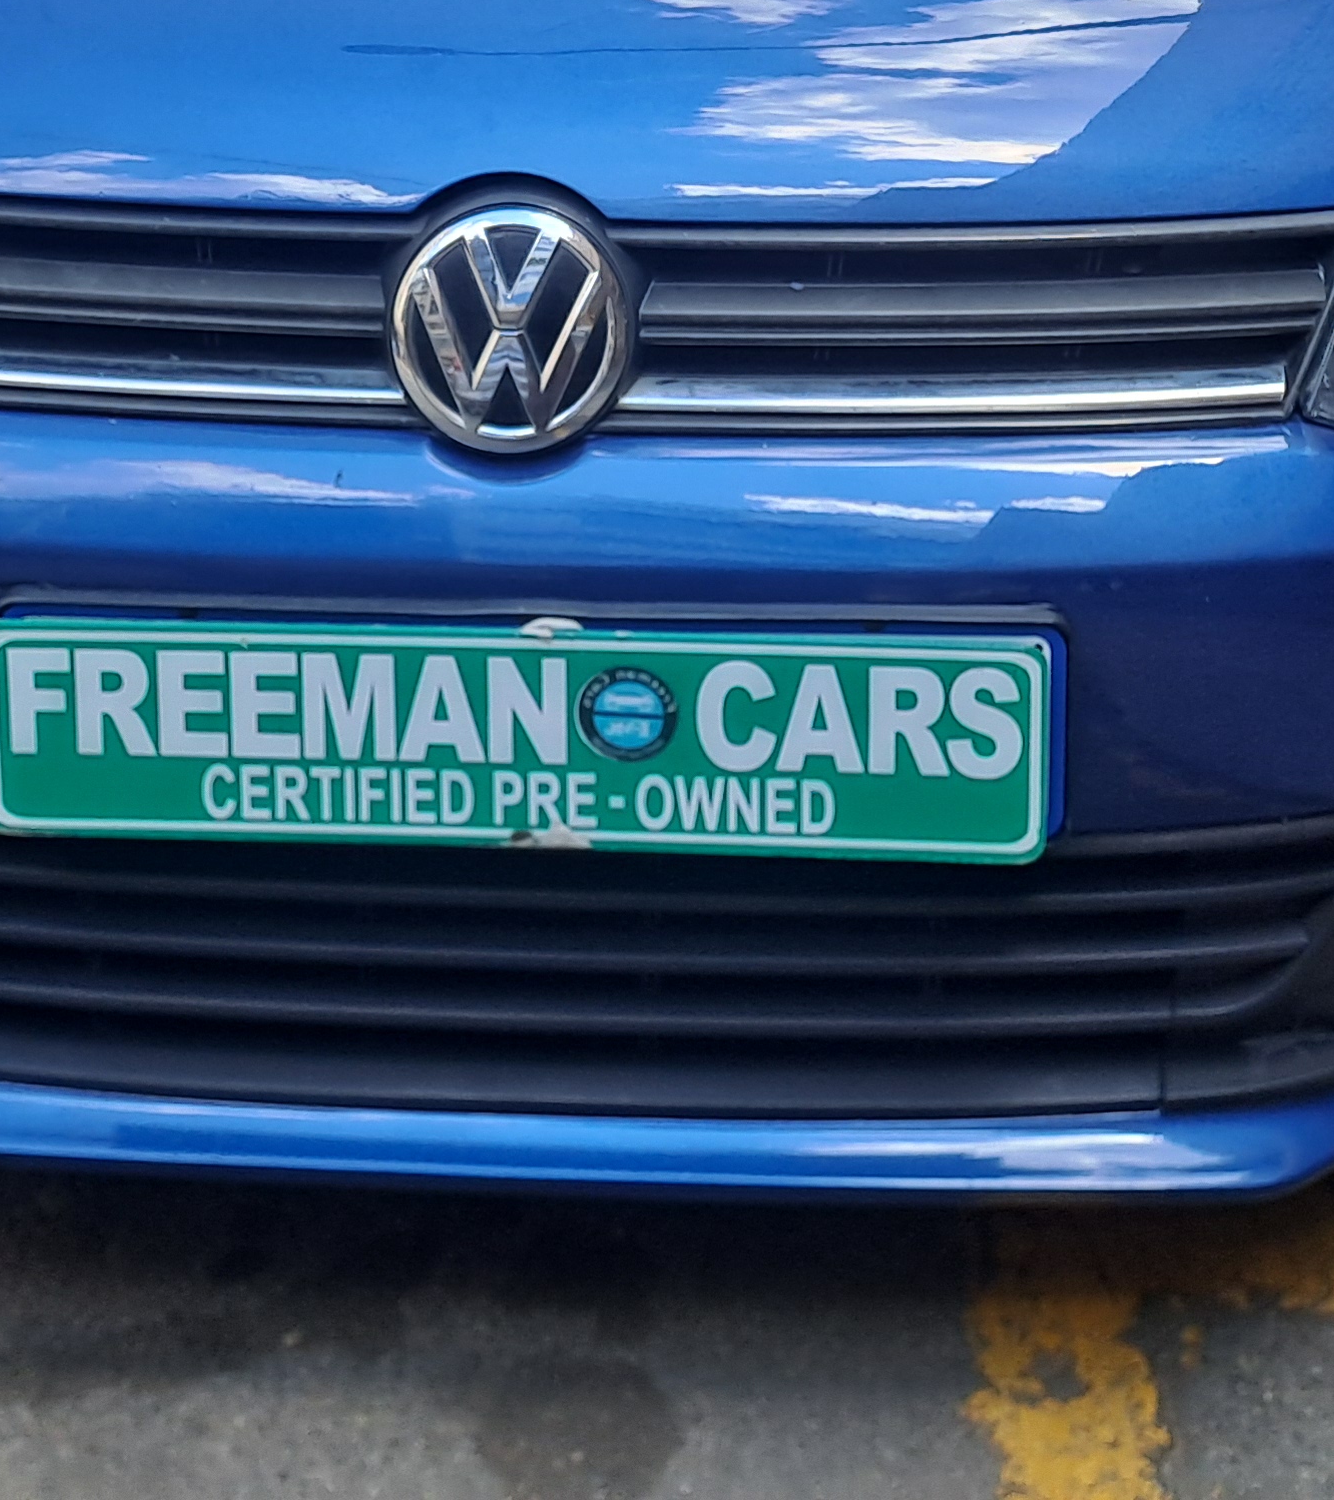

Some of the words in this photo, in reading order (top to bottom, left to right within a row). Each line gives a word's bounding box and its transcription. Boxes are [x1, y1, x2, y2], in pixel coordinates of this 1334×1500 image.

[6, 647, 567, 765] FREEMAN
[695, 660, 1024, 780] CARS
[201, 763, 475, 825] CERTIFIED
